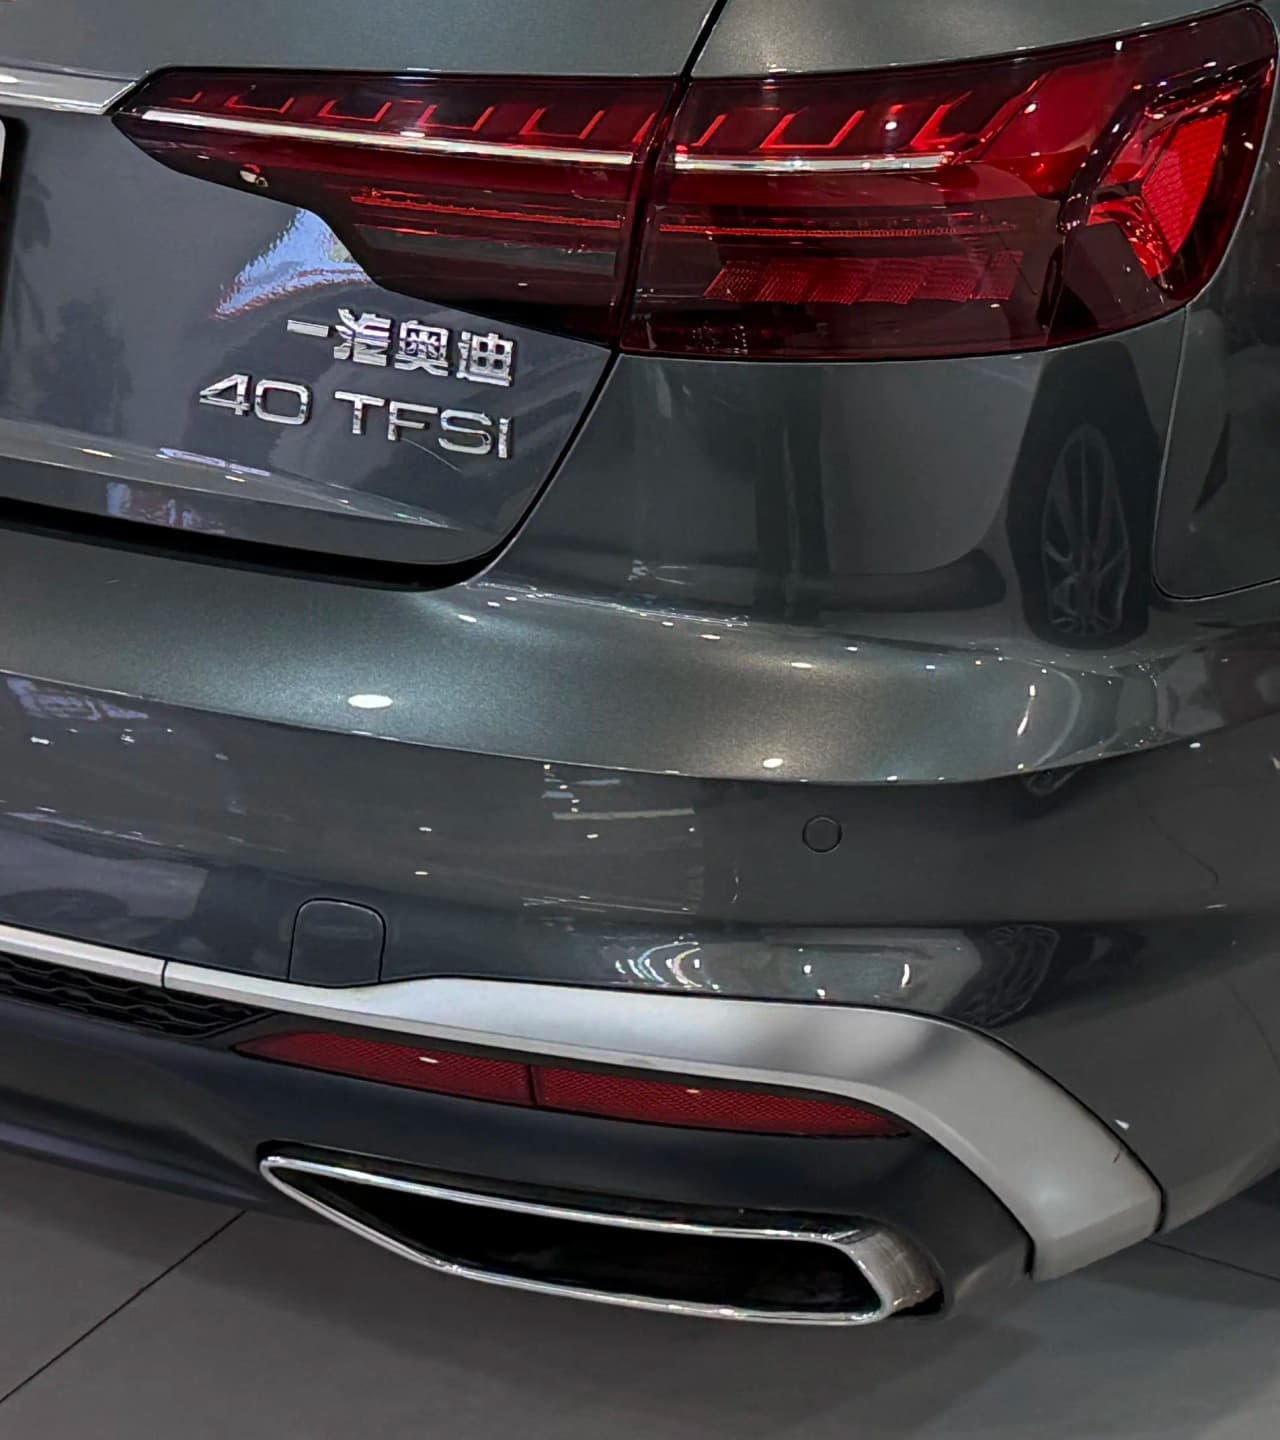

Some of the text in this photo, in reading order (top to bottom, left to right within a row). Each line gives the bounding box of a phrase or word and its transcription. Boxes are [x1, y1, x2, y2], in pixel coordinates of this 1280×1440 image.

[286, 307, 514, 388] 一汽奥迪
[198, 372, 513, 459] 40 TFSI
